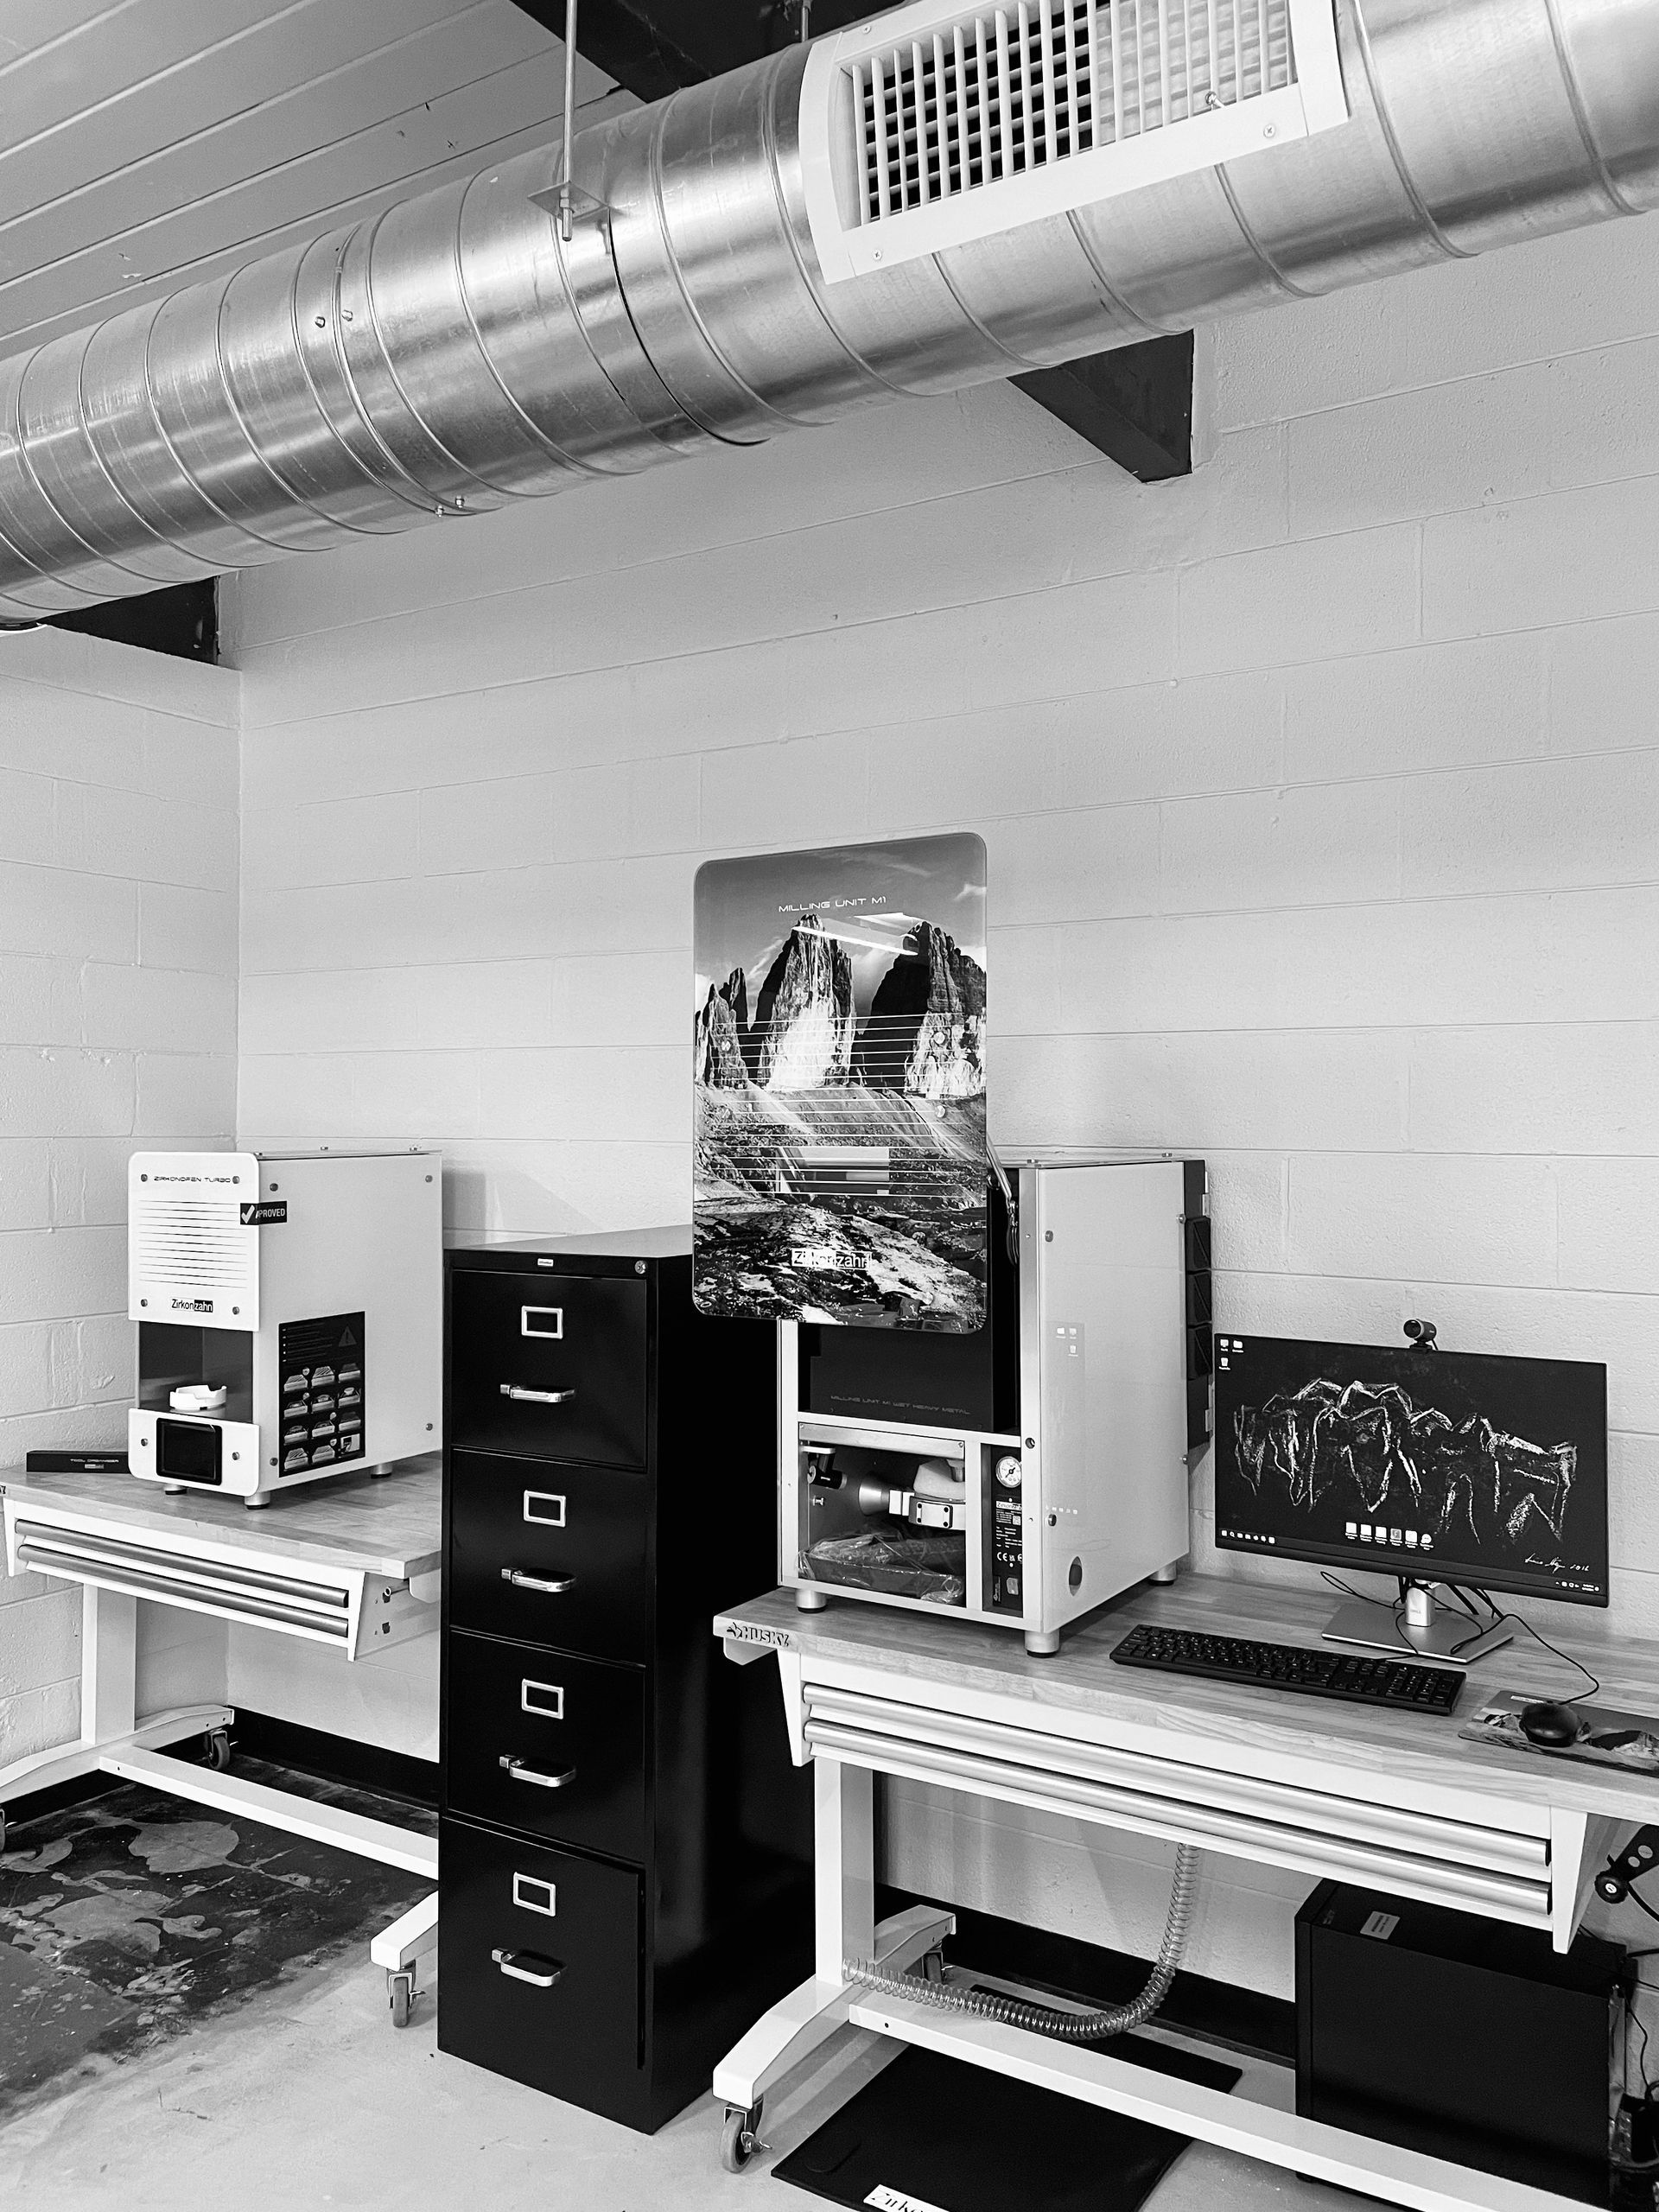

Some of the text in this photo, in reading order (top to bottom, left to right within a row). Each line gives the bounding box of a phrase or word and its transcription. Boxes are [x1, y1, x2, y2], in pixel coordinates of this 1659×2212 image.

[779, 896, 887, 912] MILLING UNIT M1
[793, 1249, 870, 1268] Ziknzahn
[171, 1298, 213, 1313] Zirkonzahn
